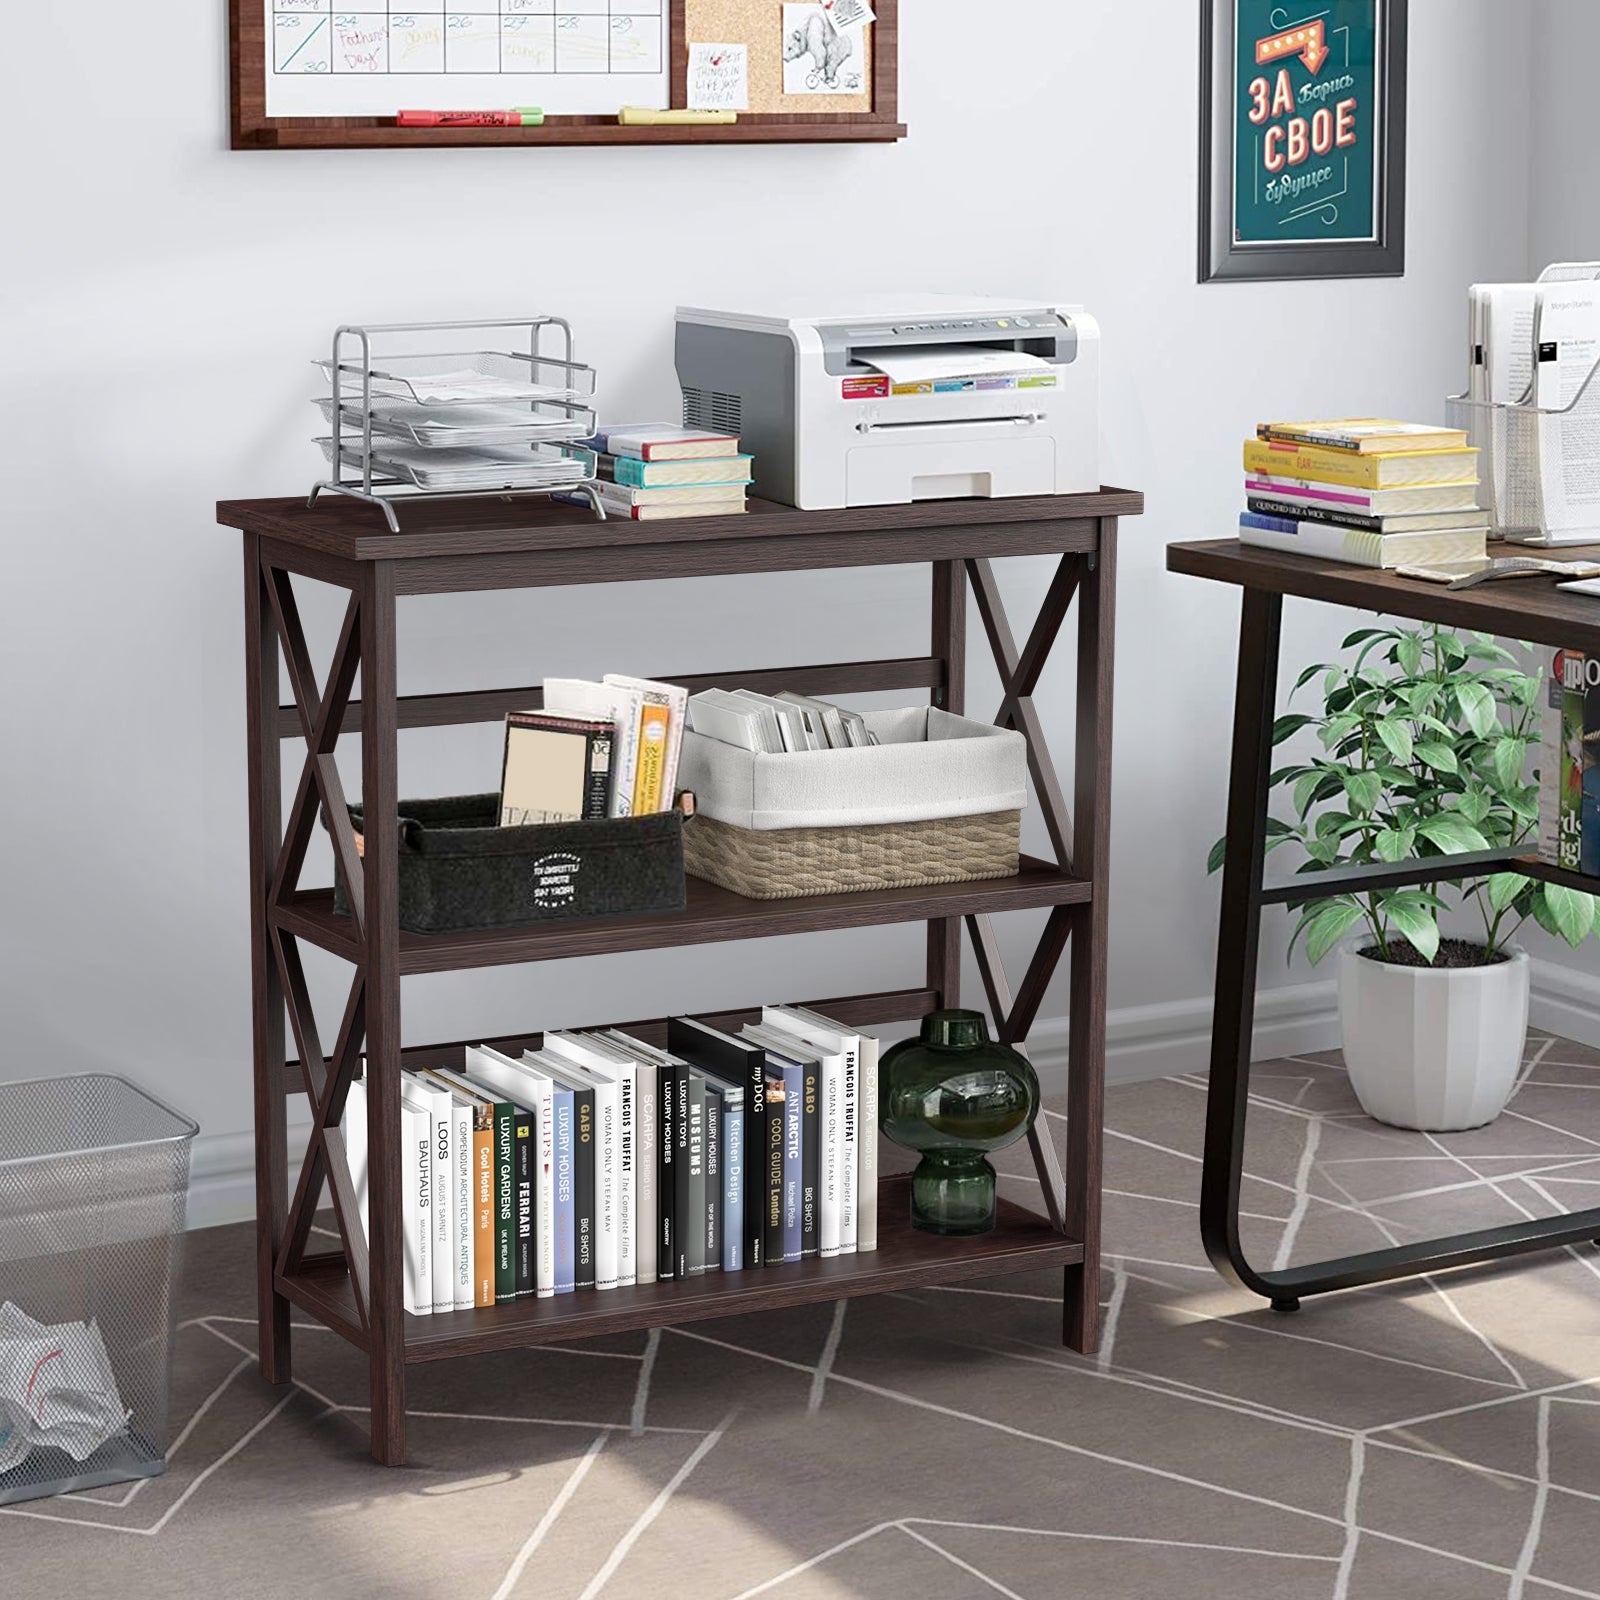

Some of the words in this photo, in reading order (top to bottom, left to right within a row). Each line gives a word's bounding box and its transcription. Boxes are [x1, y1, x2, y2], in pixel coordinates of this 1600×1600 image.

[276, 16, 300, 27] 23
[335, 16, 359, 27] 24
[392, 16, 416, 28] 25
[448, 16, 472, 28] 26
[503, 17, 528, 29] 27
[557, 17, 579, 28] 28
[612, 17, 632, 33] 29
[304, 61, 327, 72] 30
[1249, 68, 1295, 124] ЗА
[1298, 74, 1354, 104] Борись
[1264, 98, 1356, 173] СВОЕ
[1265, 166, 1333, 204] будущее
[752, 1067, 762, 1082] my
[845, 1052, 854, 1098] FRANCOIS
[622, 1079, 631, 1127] FRANCOIS
[754, 1084, 763, 1112] DOG
[806, 1076, 815, 1114] GABO
[866, 1067, 875, 1122] SCARPA
[438, 1121, 448, 1160] LOOS
[500, 1117, 510, 1162] LUXURY
[543, 1095, 551, 1158] TULIPS
[558, 1106, 568, 1153] LUXURY
[580, 1104, 590, 1143] GABO
[643, 1094, 653, 1150] SCARPA
[691, 1104, 701, 1176] MUSEUMS
[708, 1107, 716, 1139] LUXURY
[771, 1118, 781, 1148] COOL
[789, 1091, 799, 1159] ANTARCTIC
[845, 1103, 854, 1142] TRUFFAT
[459, 1122, 467, 1176] COMPENDIUM
[480, 1147, 490, 1169] Cool
[622, 1132, 631, 1172] TRUFFAT
[730, 1120, 740, 1162] Kitchen
[419, 1140, 429, 1208] BAUHAUS
[559, 1156, 569, 1202] HOUSES
[728, 1167, 740, 1204] Design
[771, 1152, 780, 1185] GUIDE
[843, 1165, 852, 1202] Complete
[438, 1175, 446, 1205] AUGUST
[480, 1172, 490, 1203] Hotels
[501, 1166, 510, 1220] GARDENS
[543, 1186, 549, 1197] BY
[805, 1187, 813, 1202] BIG
[438, 1209, 446, 1242] SARNITZ
[460, 1178, 468, 1243] ARCHITECTURAL
[481, 1209, 489, 1229] Paris
[519, 1182, 530, 1237] FERRARI
[580, 1218, 588, 1233] BIG
[620, 1195, 629, 1234] Complete
[771, 1189, 780, 1226] London
[787, 1207, 795, 1228] Poliza
[805, 1204, 813, 1232] SHOTS
[844, 1206, 852, 1227] Films
[501, 1229, 507, 1238] UK
[580, 1235, 589, 1264] SHOTS
[460, 1245, 469, 1285] ANTIQUES
